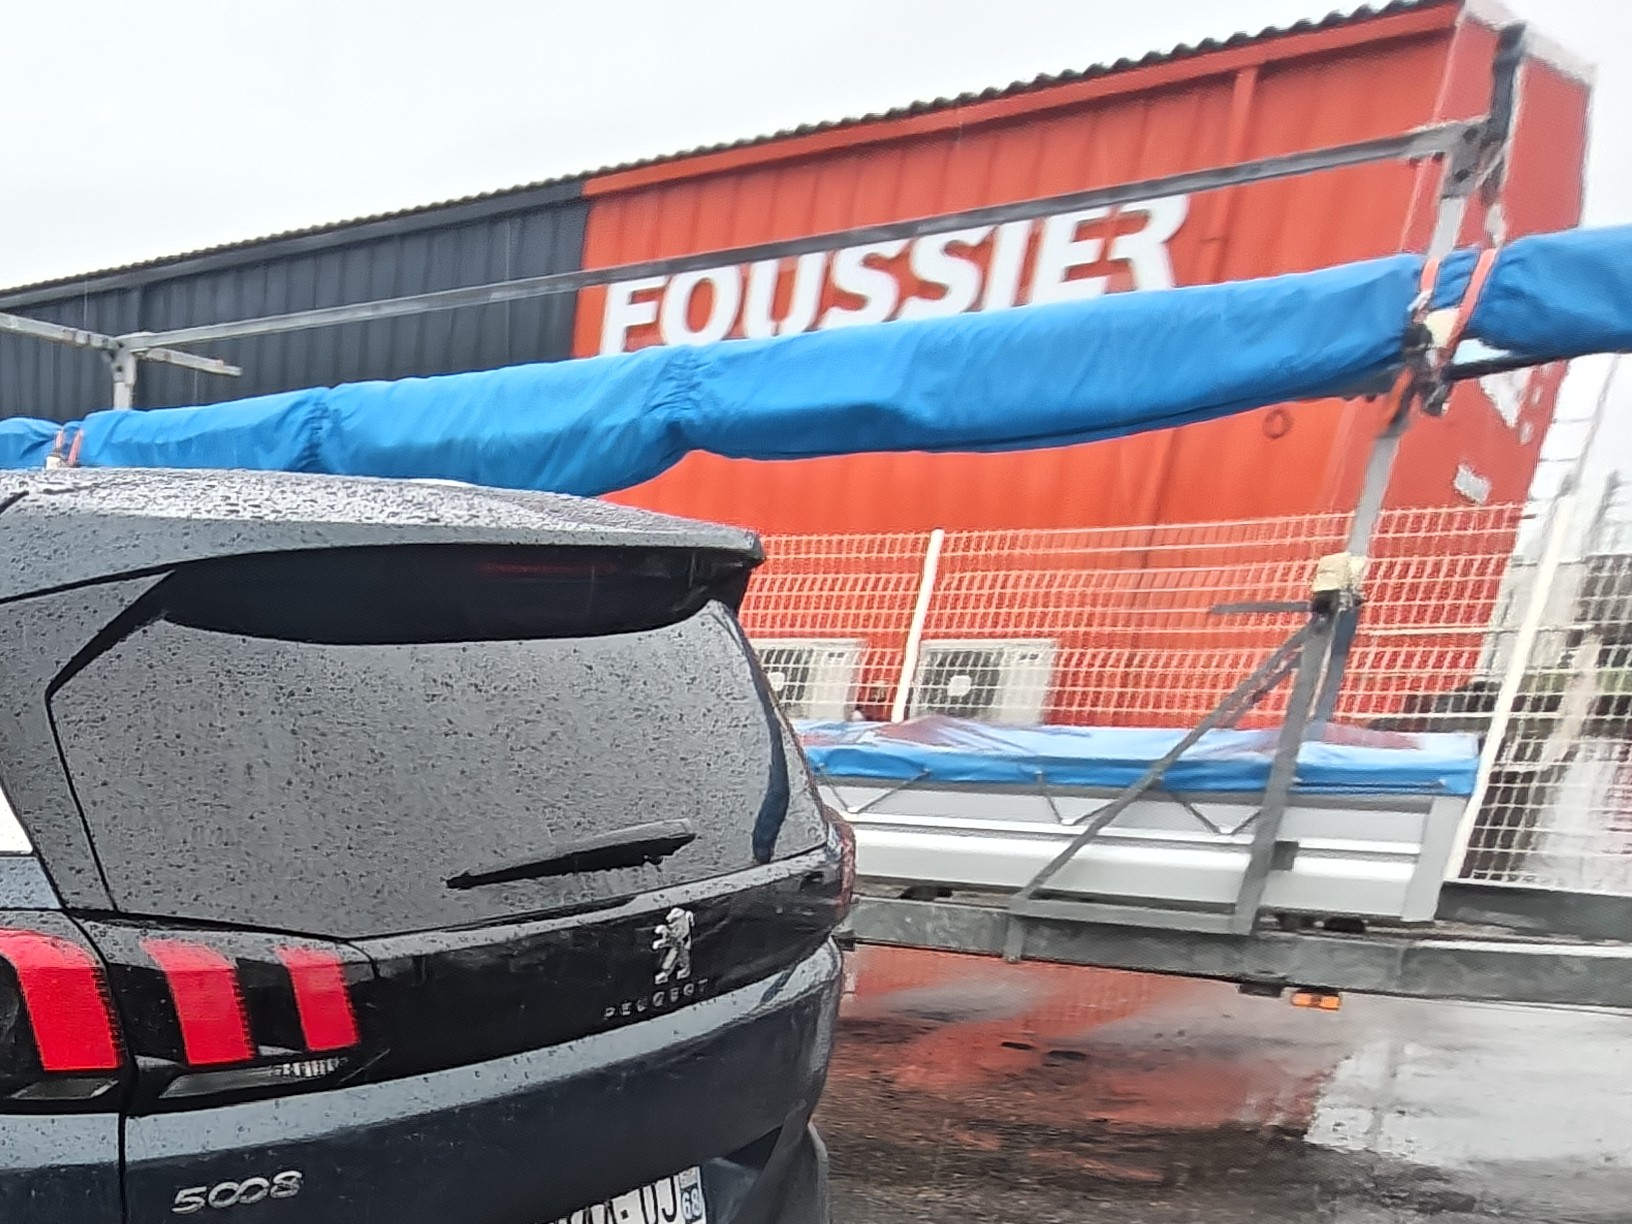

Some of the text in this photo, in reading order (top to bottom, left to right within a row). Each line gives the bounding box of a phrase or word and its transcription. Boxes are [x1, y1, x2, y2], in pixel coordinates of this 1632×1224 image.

[599, 194, 1191, 356] FOUSSIER
[604, 979, 708, 1020] PEUGEOT
[171, 1169, 303, 1214] 5008
[682, 1188, 702, 1220] 68
